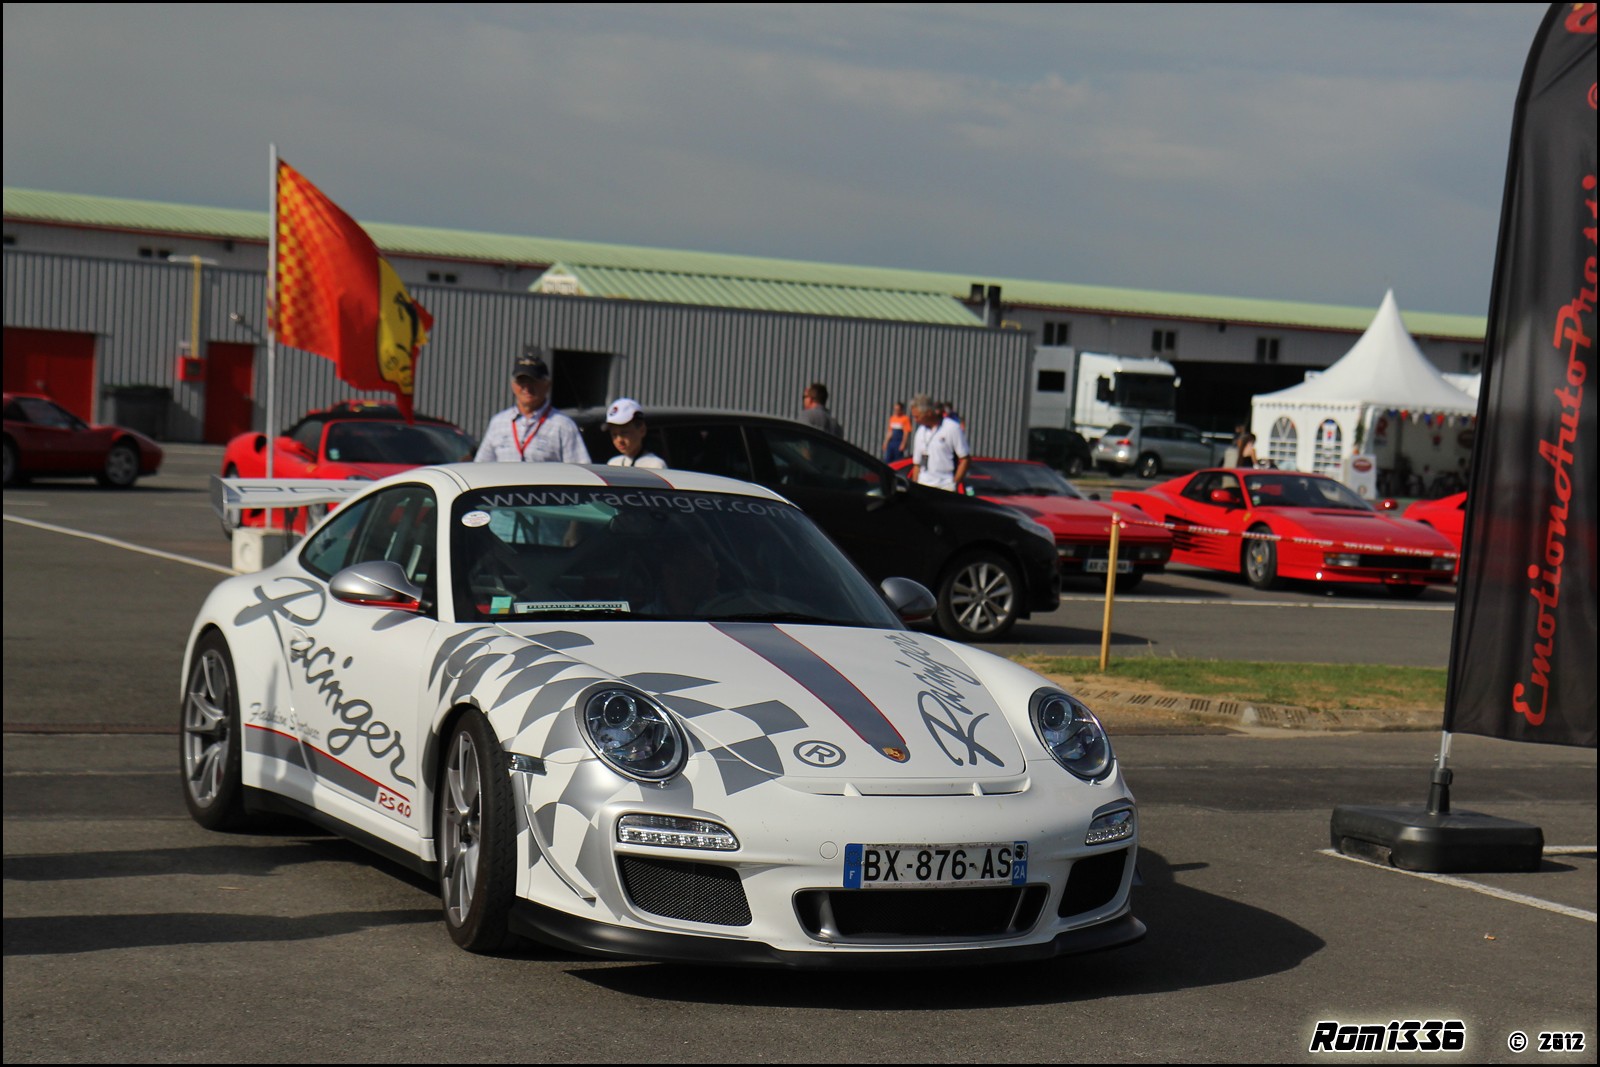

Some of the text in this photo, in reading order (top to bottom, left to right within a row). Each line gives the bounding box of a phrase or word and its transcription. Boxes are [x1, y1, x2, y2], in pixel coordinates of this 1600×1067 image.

[481, 490, 798, 520] www.racinger.com
[233, 577, 417, 789] Racinger
[885, 632, 1005, 767] Racinger
[378, 792, 395, 811] RS
[849, 870, 855, 880] F
[1013, 865, 1026, 880] 2A
